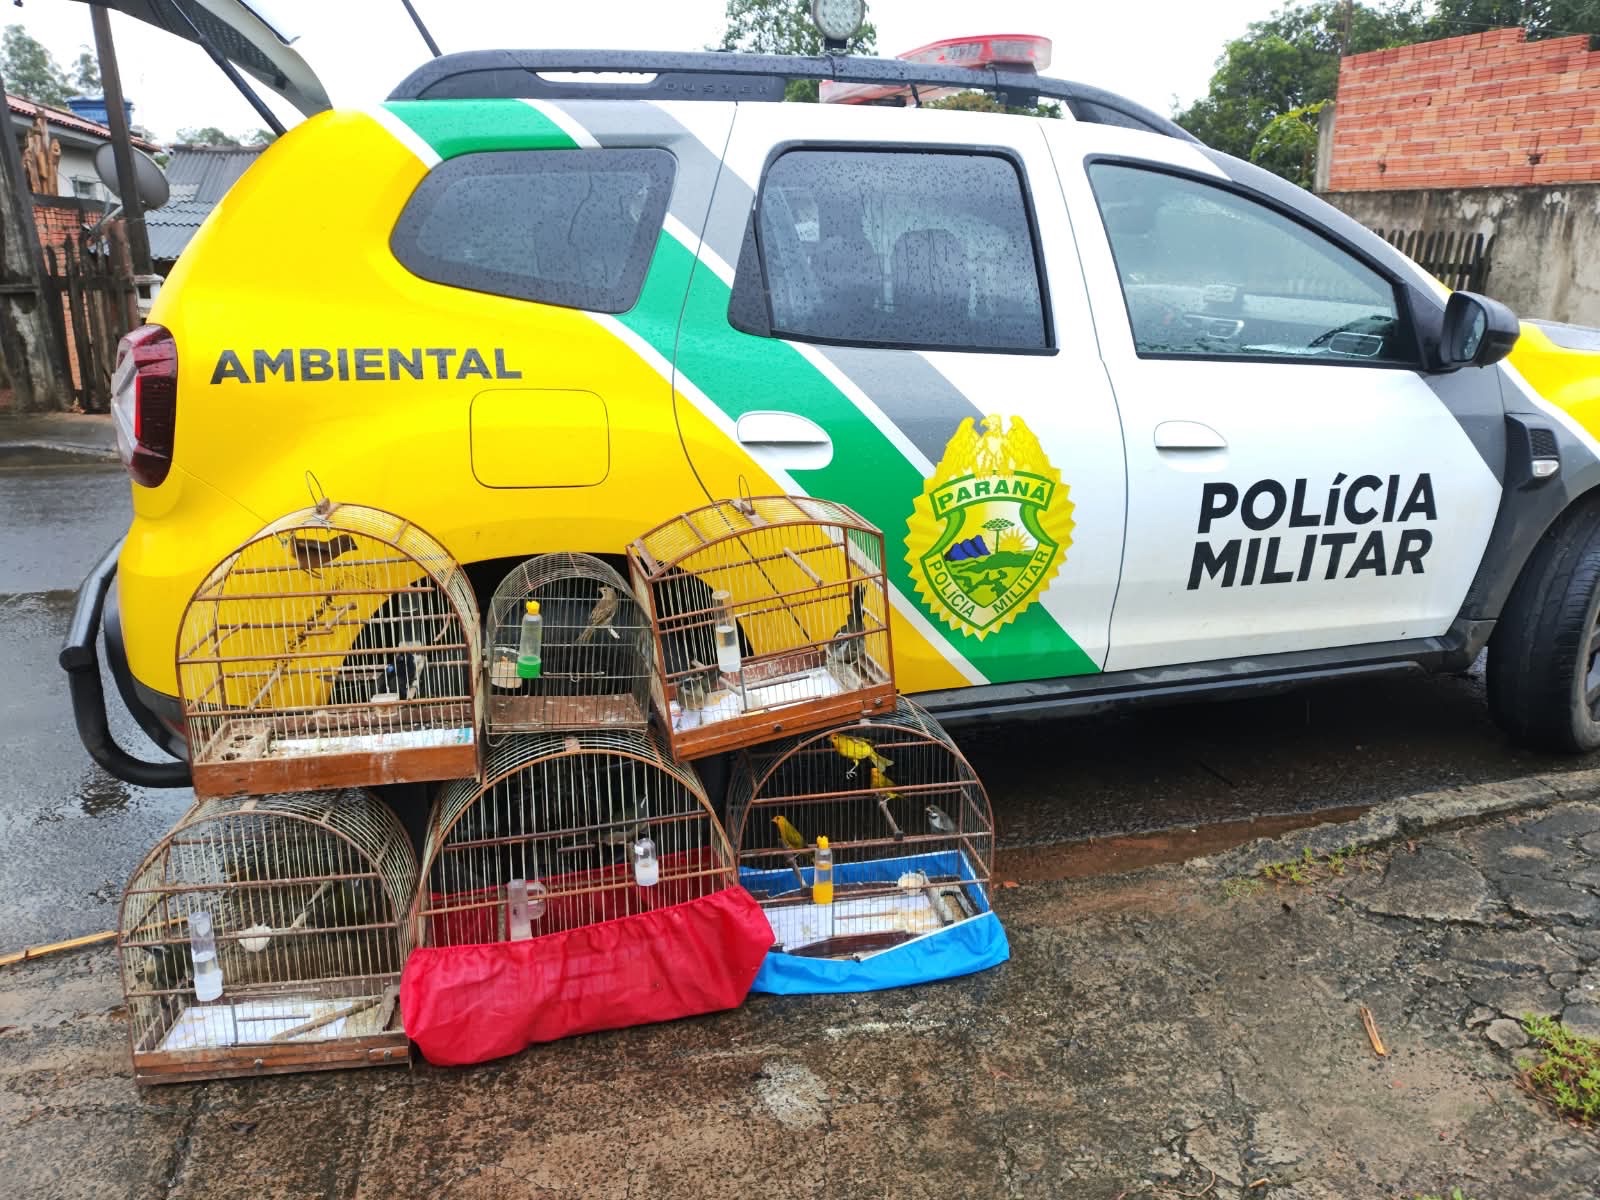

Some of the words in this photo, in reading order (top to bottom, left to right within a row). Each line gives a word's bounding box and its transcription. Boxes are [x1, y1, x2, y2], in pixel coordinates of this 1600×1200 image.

[664, 81, 769, 95] DUSTER
[210, 347, 523, 385] AMBIENTAL
[937, 479, 1047, 511] PARANÁ
[1186, 528, 1433, 590] MILITAR
[928, 559, 977, 618] POLÍCIA
[991, 550, 1049, 614] MILITAR
